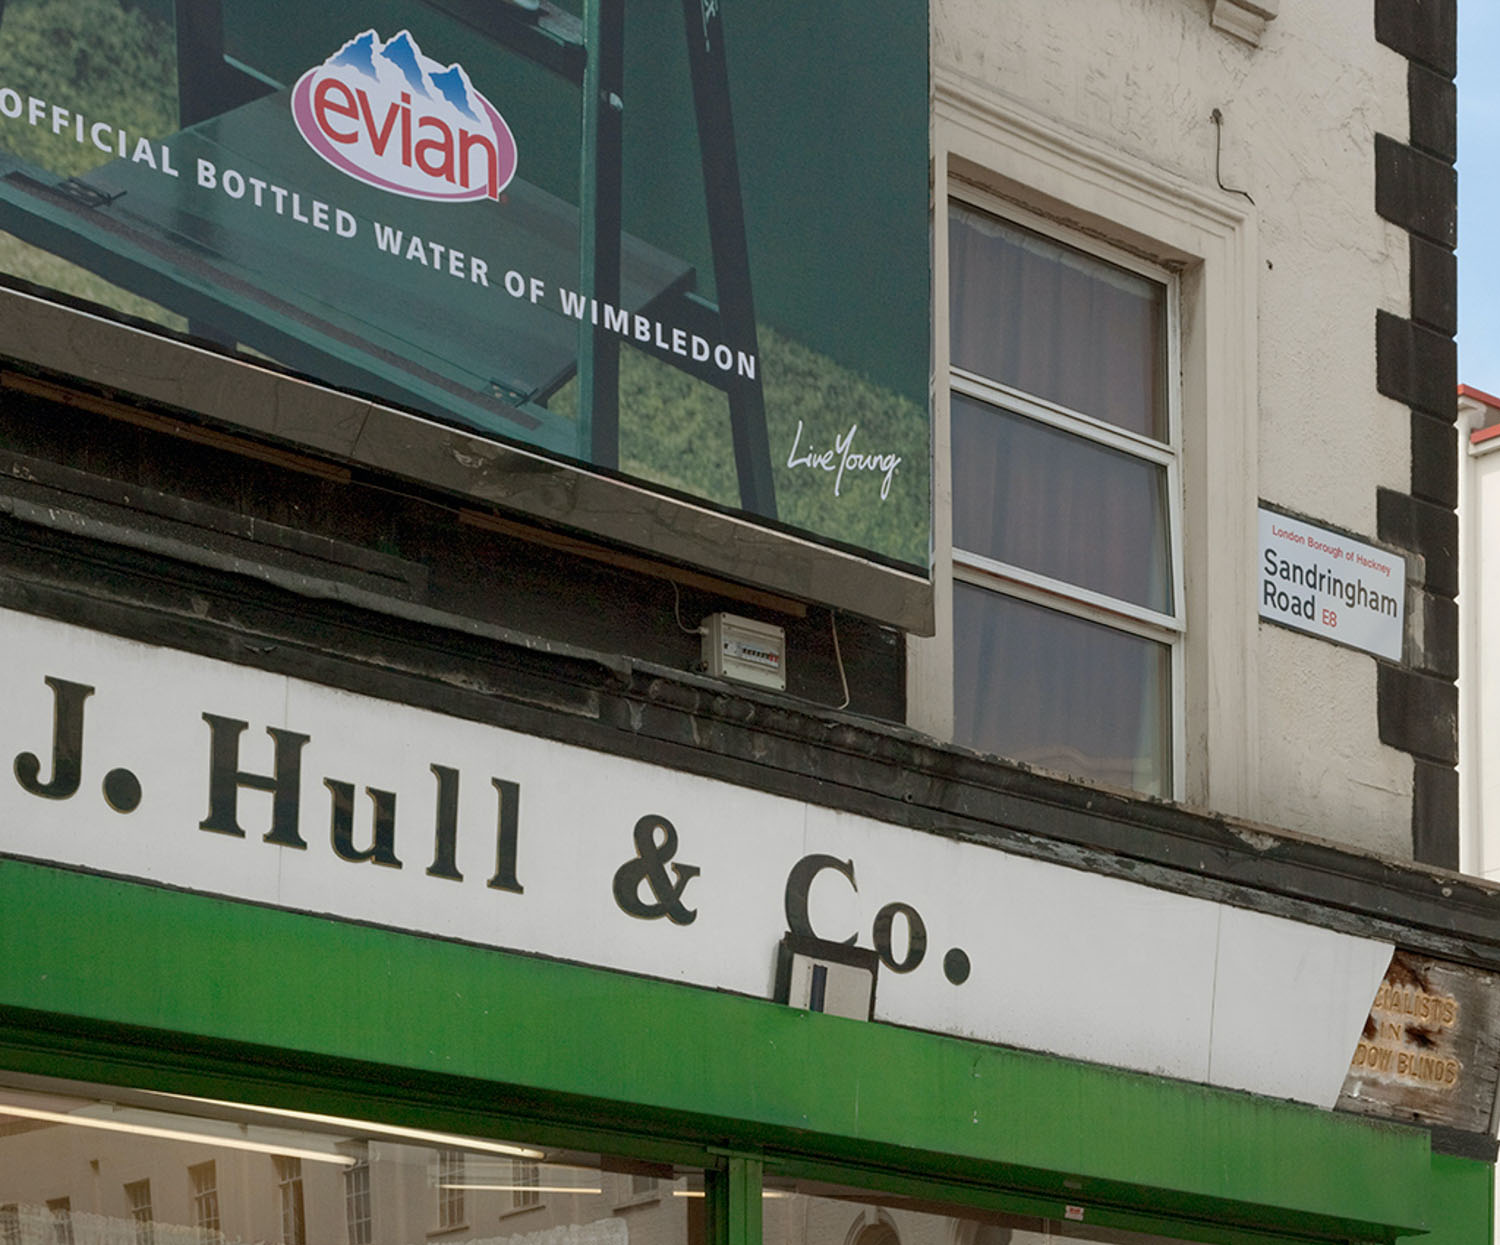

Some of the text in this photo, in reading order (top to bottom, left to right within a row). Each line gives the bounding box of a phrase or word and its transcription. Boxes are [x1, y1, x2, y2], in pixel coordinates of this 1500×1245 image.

[313, 76, 500, 200] evian
[0, 86, 758, 381] OFFICIAL BOTTLED WATER OF WIMBLEDON
[787, 420, 902, 500] Live Young
[1264, 548, 1398, 618] Sandringham
[1272, 525, 1392, 577] London Borough of Hackney
[1263, 579, 1338, 628] Road E8
[13, 675, 971, 985] J. Hull & Co.
[1381, 1021, 1402, 1041] IN
[1397, 1052, 1456, 1084] BLINDS
